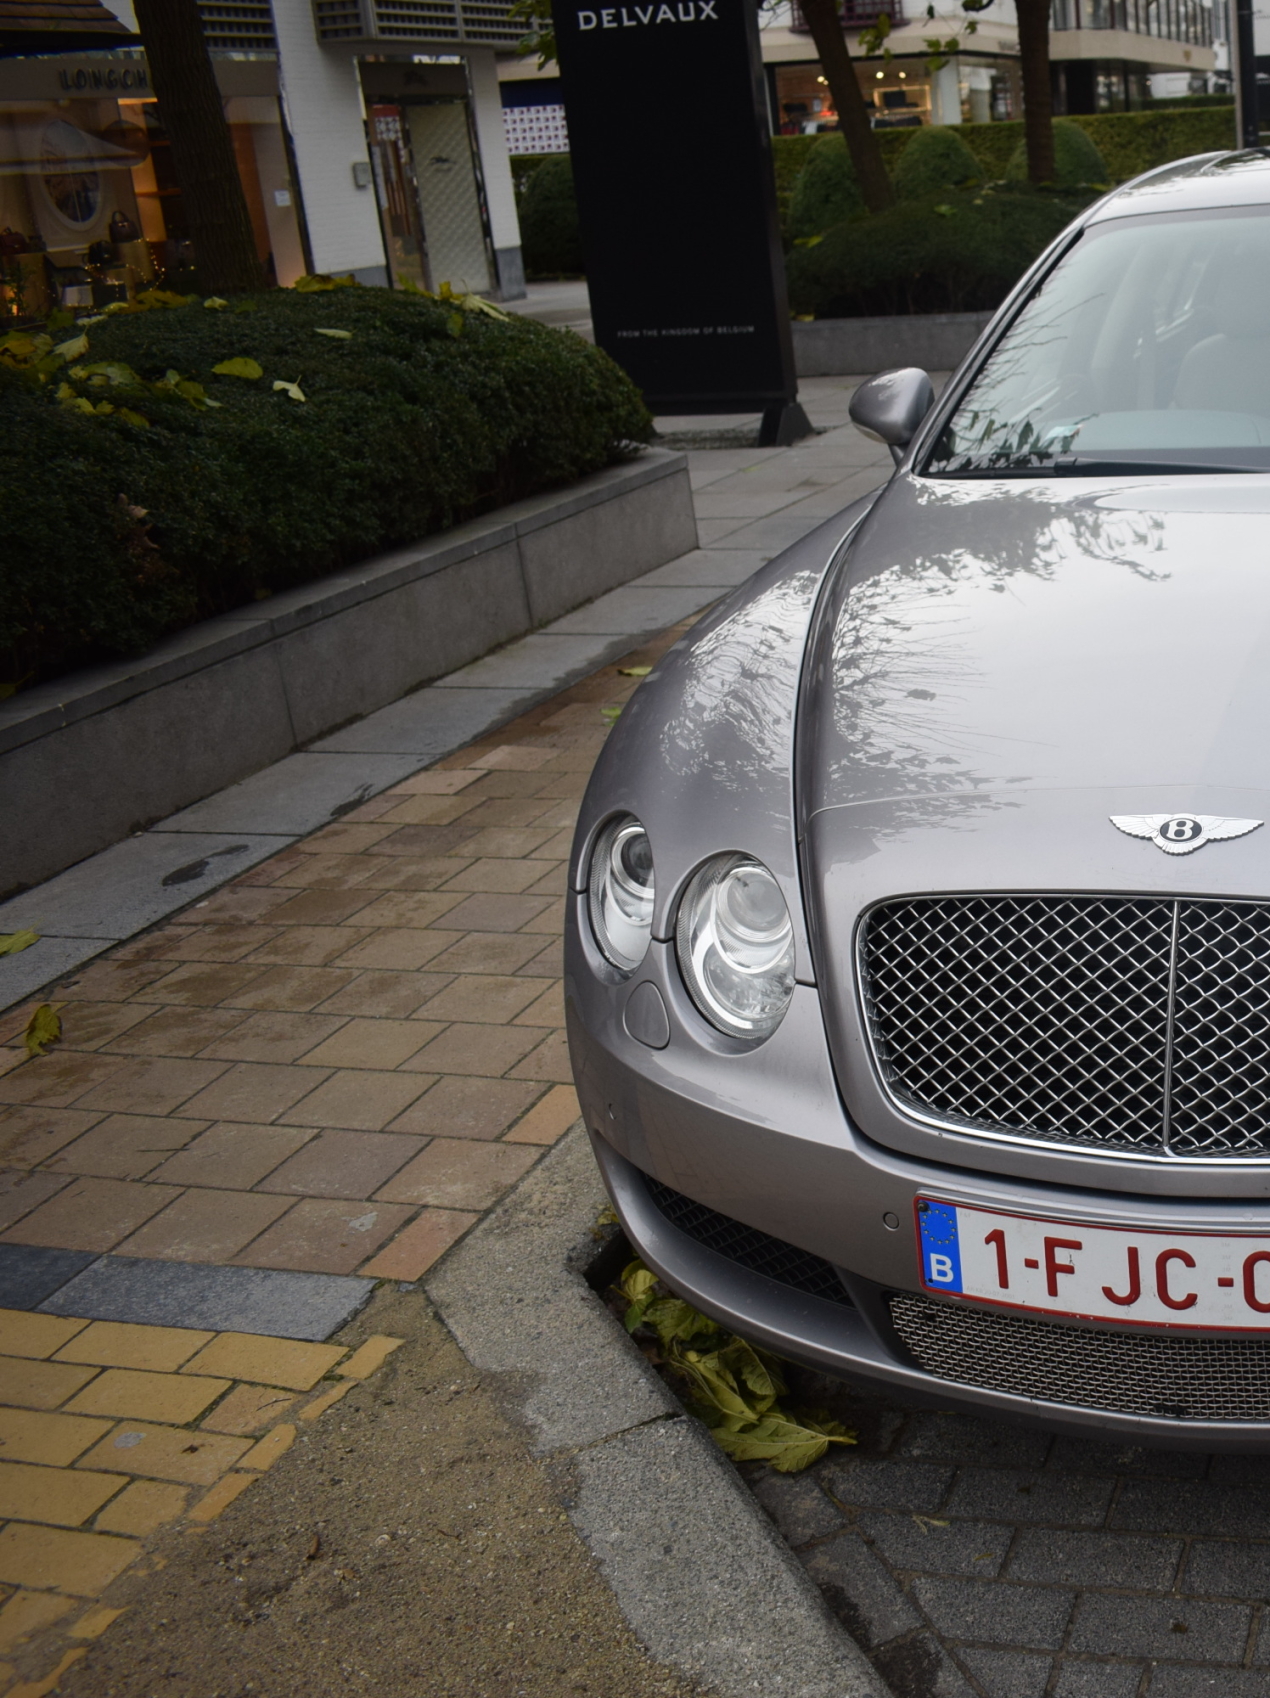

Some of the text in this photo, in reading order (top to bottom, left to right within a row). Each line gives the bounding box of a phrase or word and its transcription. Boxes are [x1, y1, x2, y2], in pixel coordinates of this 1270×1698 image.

[577, 1, 718, 30] DELVAUX
[617, 325, 755, 338] FROM THE KINGDOM OF BELGIUM
[930, 1253, 954, 1283] B
